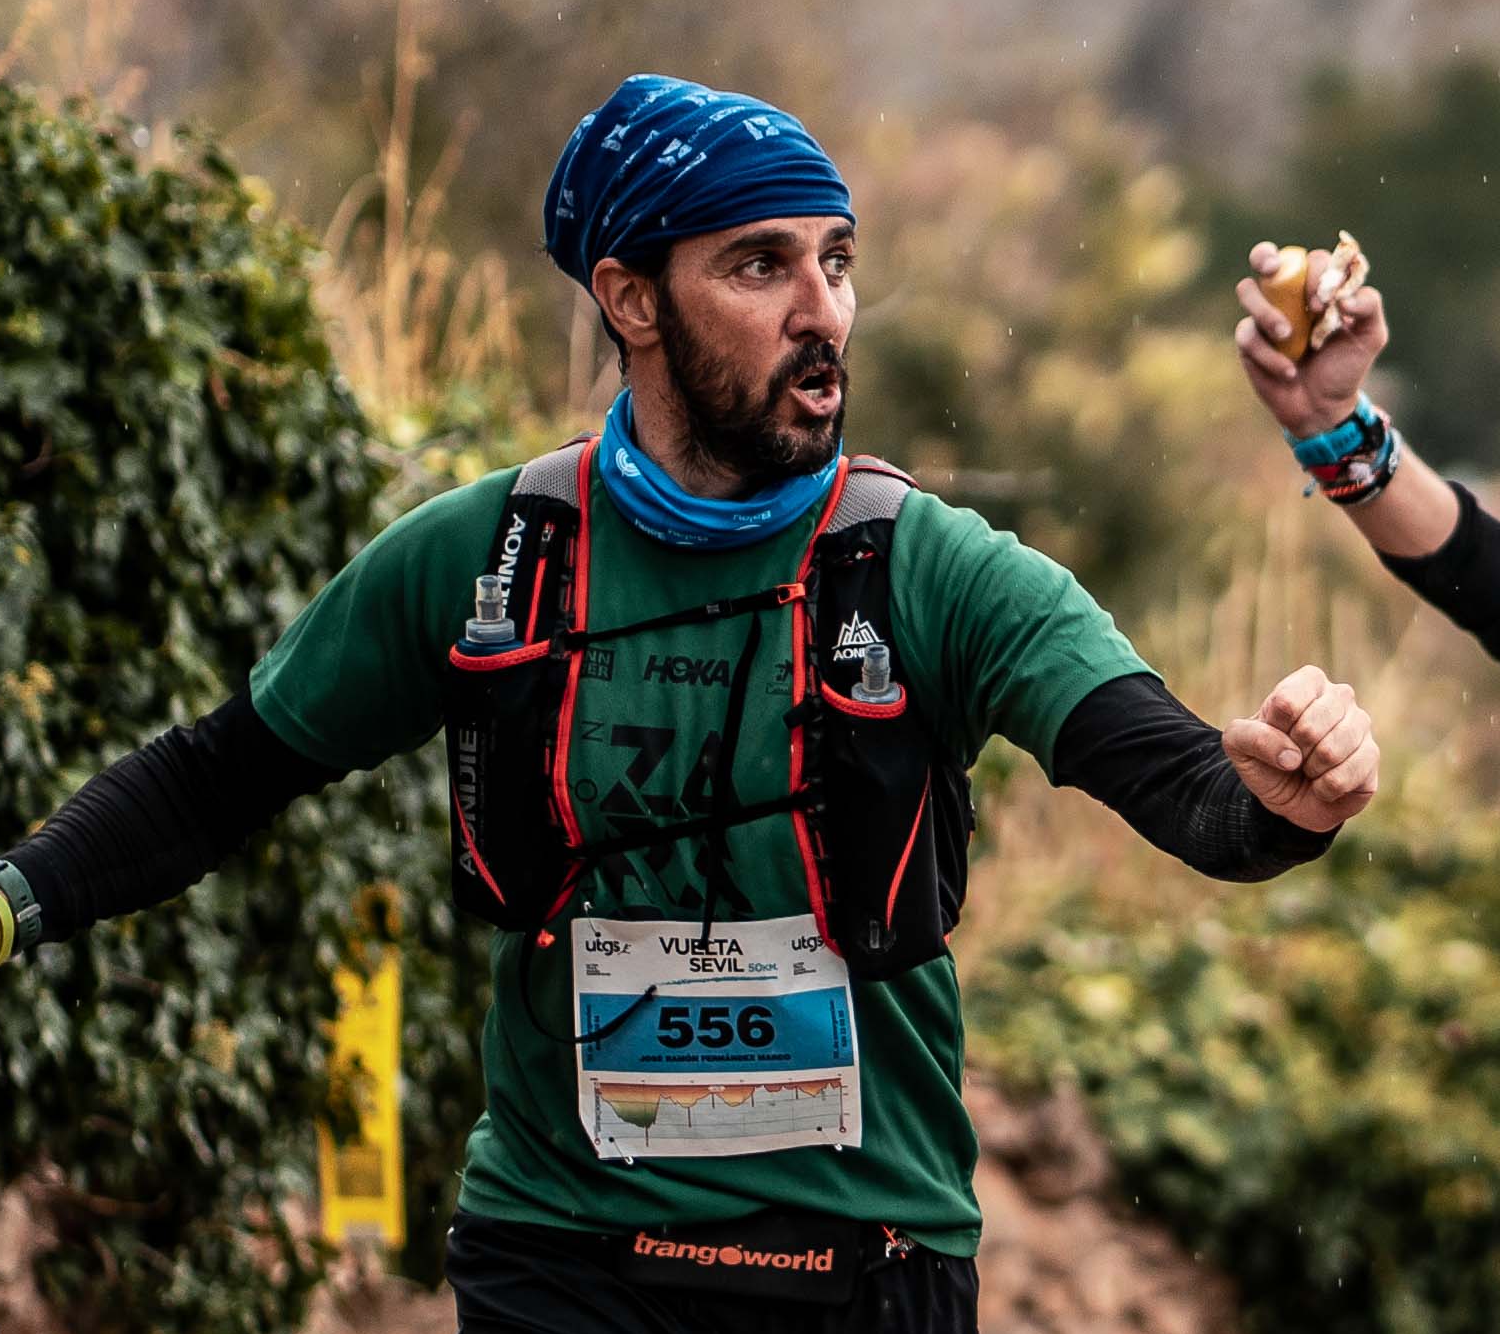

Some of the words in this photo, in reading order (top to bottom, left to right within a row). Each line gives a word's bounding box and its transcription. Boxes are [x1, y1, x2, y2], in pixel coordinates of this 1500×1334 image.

[643, 654, 730, 687] HOKA
[585, 938, 620, 956] utgs
[659, 936, 744, 956] VUELTA
[689, 957, 745, 973] SEVIL
[657, 1006, 775, 1050] 556
